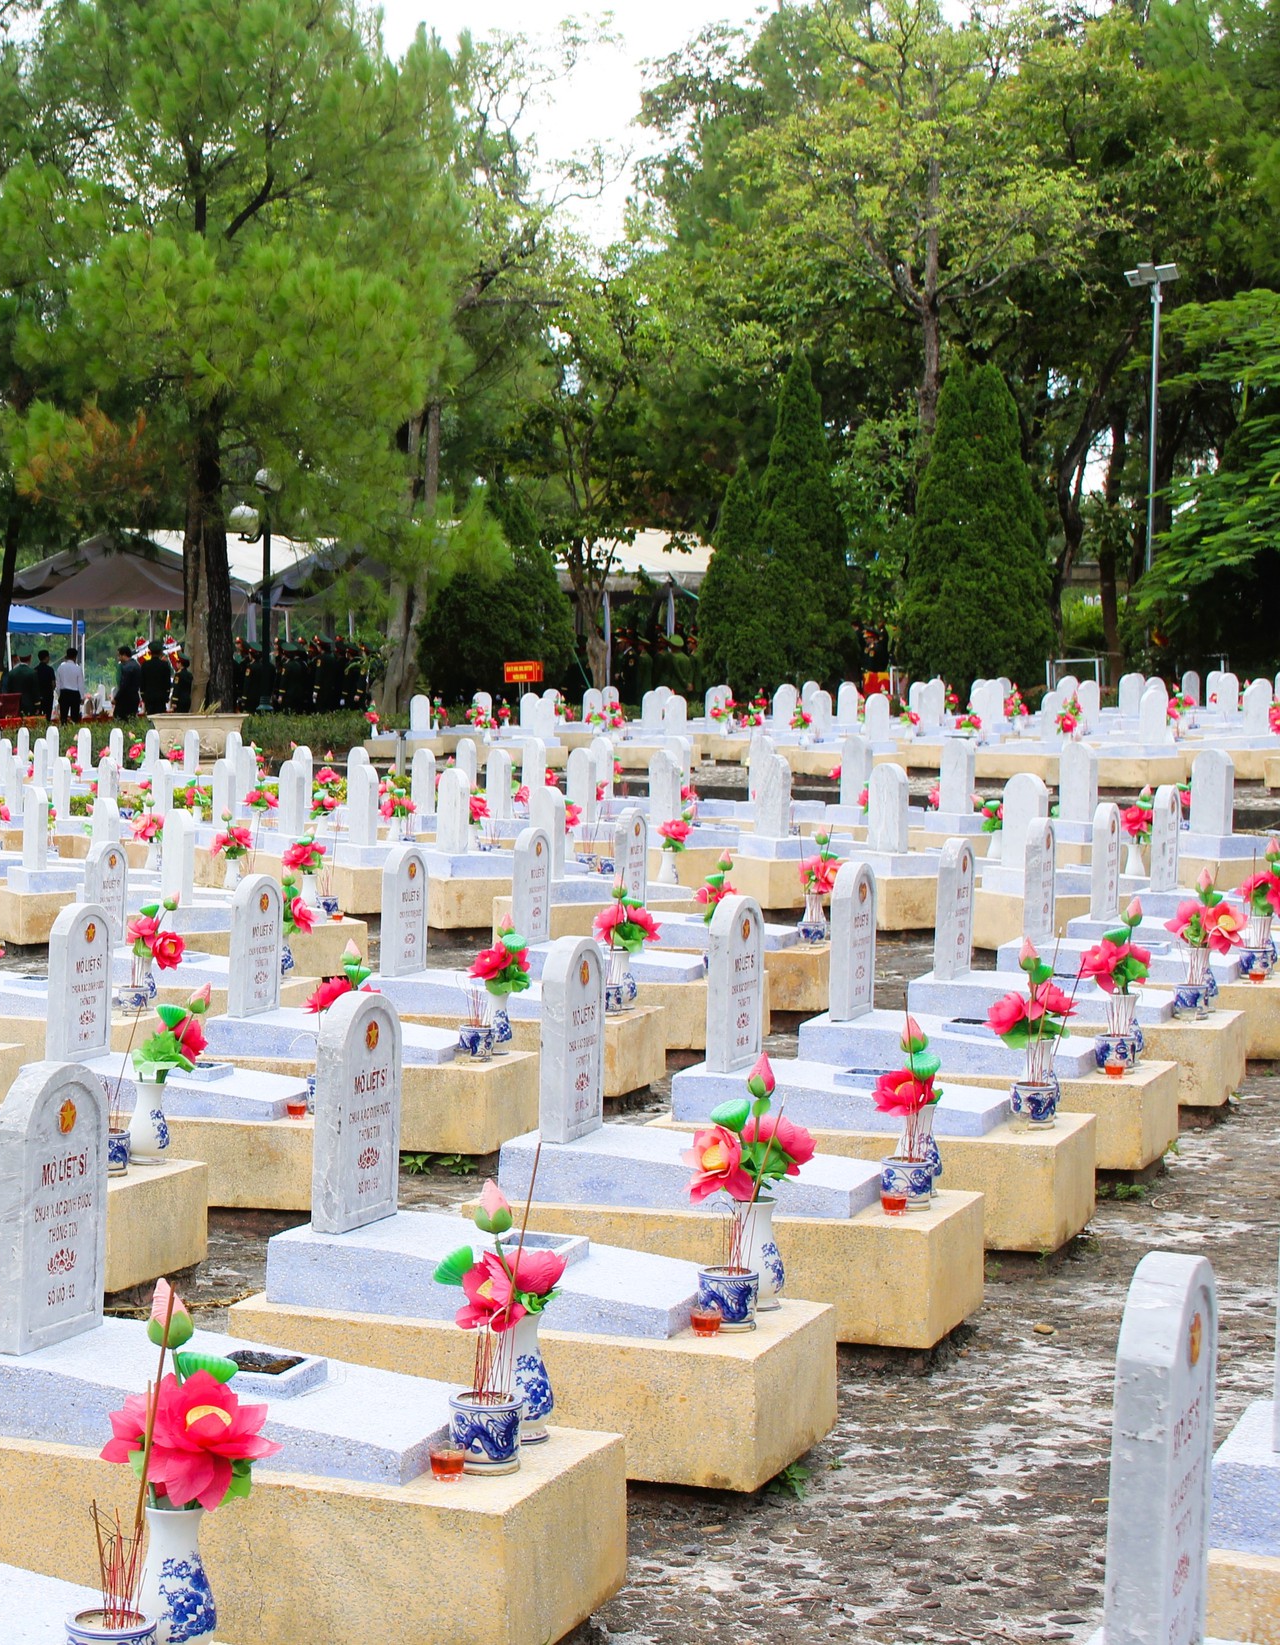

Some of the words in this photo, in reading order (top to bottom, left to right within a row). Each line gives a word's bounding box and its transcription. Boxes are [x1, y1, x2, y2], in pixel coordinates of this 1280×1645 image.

[42, 1156, 57, 1191] MỘ
[59, 1152, 77, 1186] LIỆT
[79, 1147, 88, 1175] SĨ
[49, 1223, 68, 1243] THÔNG
